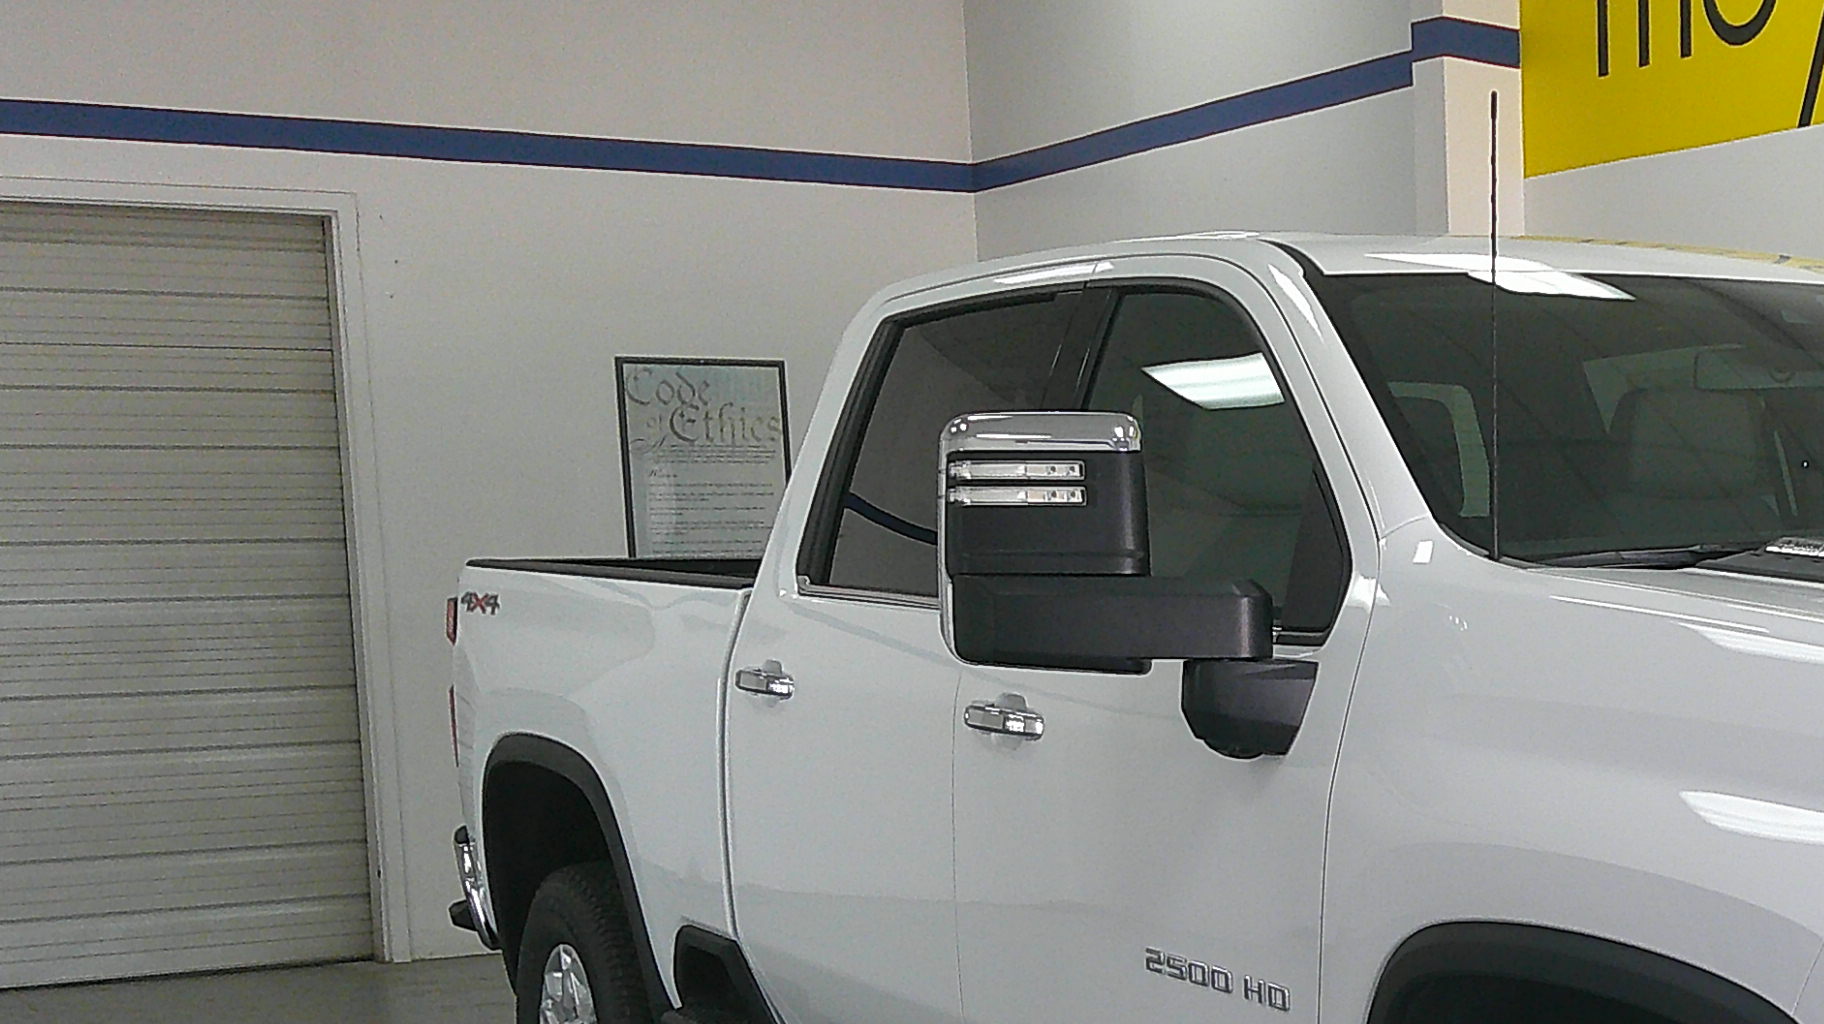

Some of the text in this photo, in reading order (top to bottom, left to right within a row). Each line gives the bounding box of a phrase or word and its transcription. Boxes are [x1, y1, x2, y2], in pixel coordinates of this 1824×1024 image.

[625, 367, 711, 406] Code
[669, 402, 781, 447] Ethics
[1145, 947, 1290, 1011] 2500 HD
